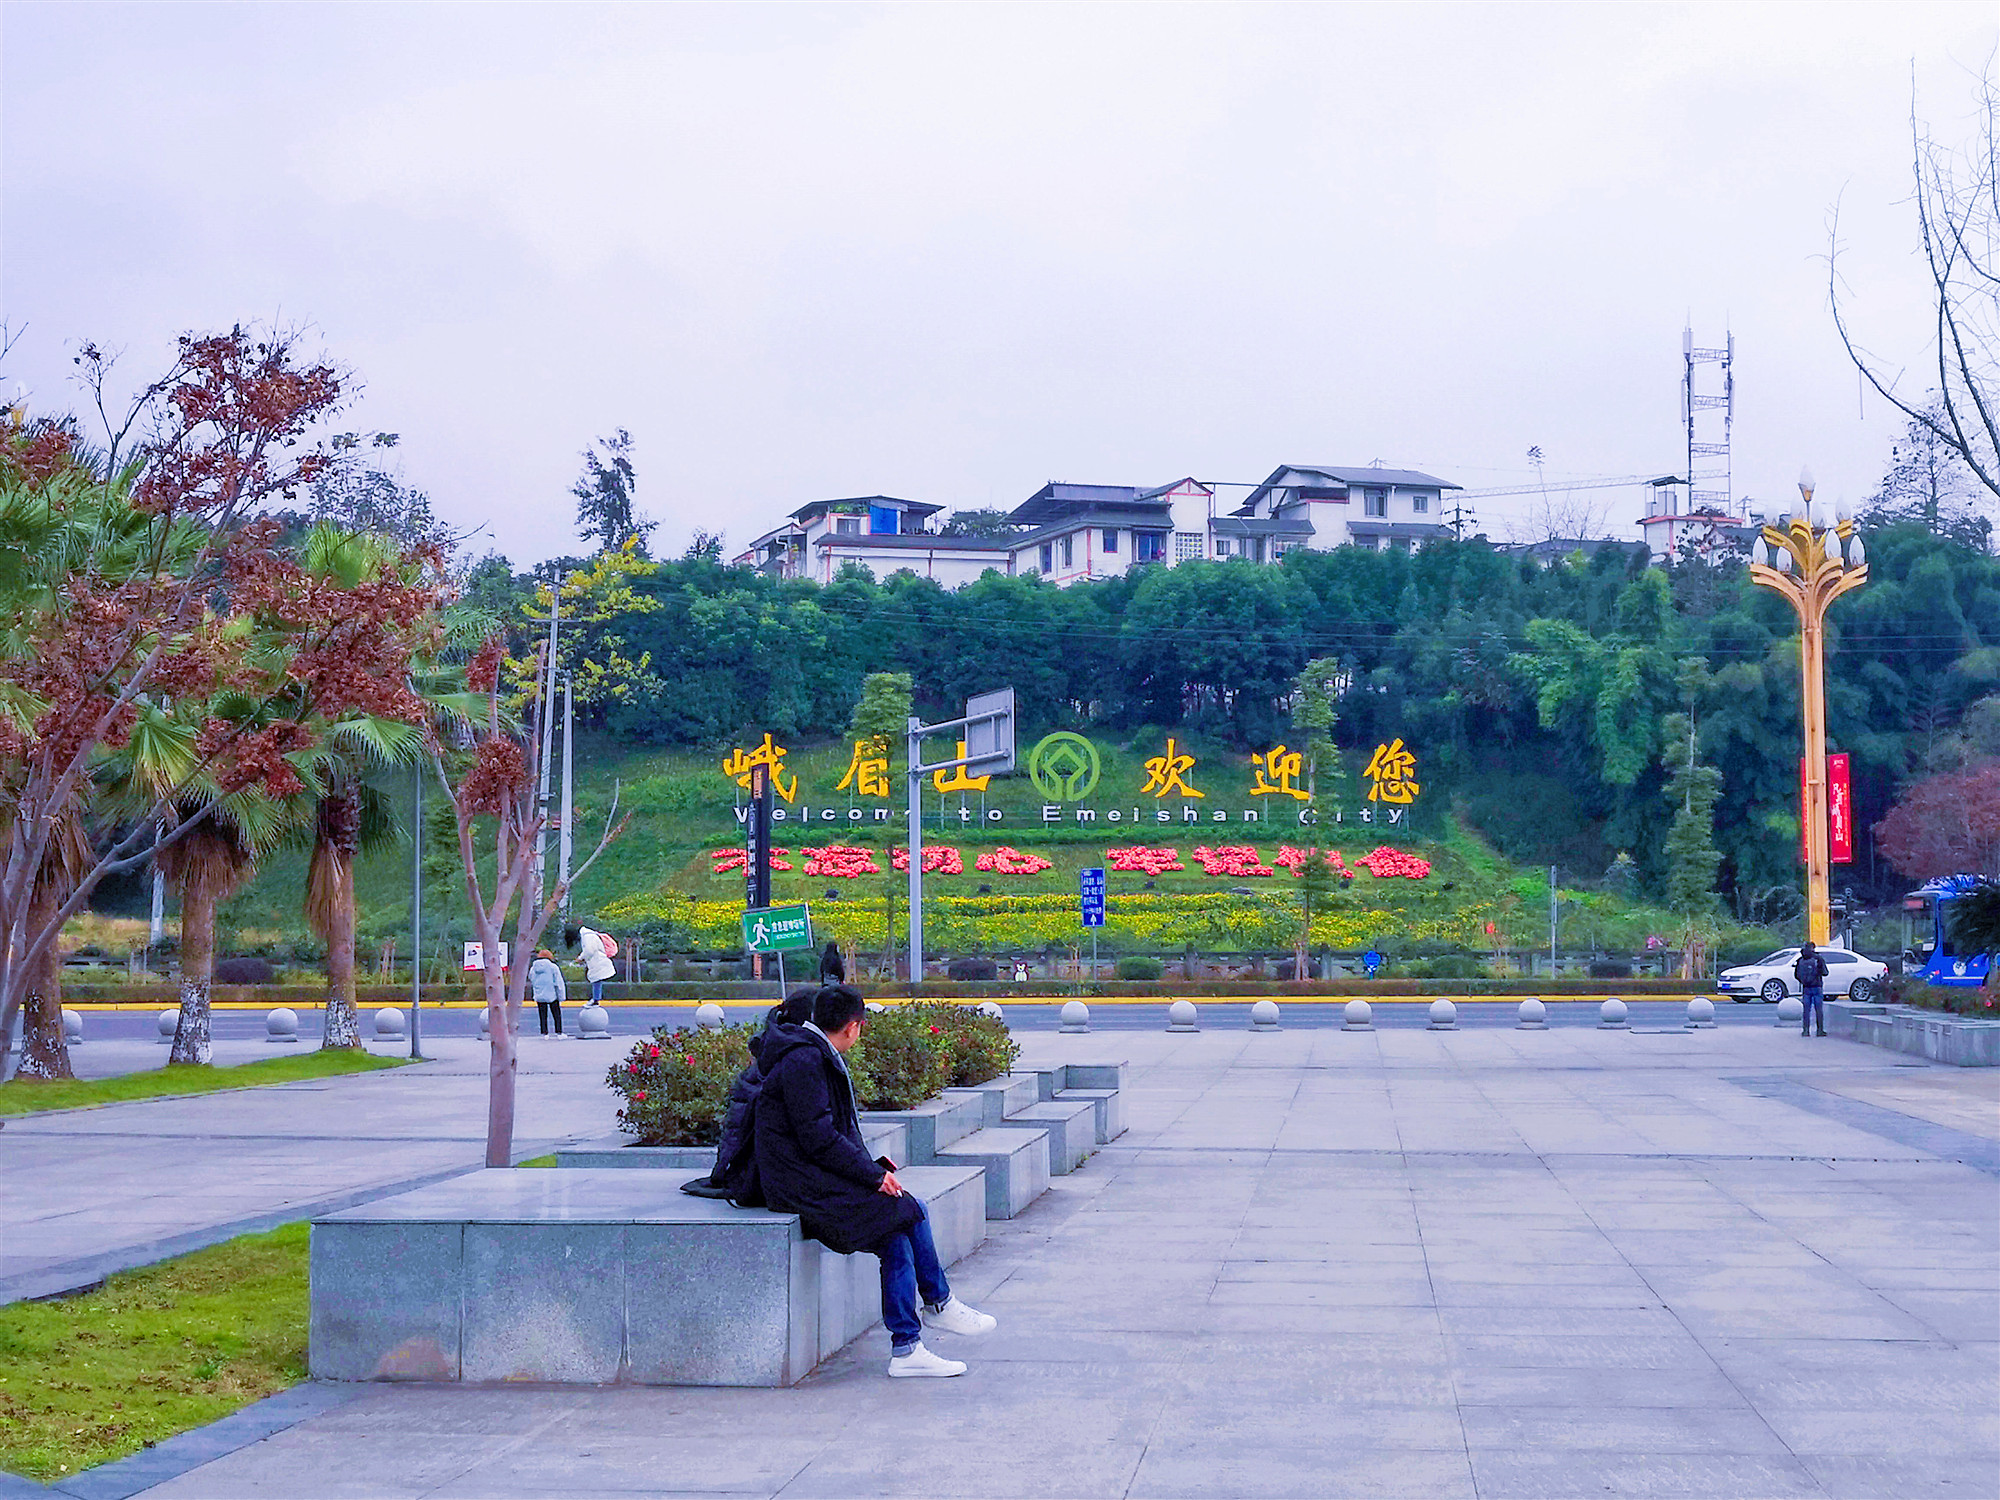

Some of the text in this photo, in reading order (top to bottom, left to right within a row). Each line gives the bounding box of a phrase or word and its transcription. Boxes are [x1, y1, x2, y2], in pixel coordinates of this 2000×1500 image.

[723, 733, 991, 803] 峨眉山
[1140, 738, 1420, 803] 欢迎您
[733, 806, 911, 823] Welcom
[957, 807, 1003, 822] to
[1042, 805, 1258, 822] Emeishan
